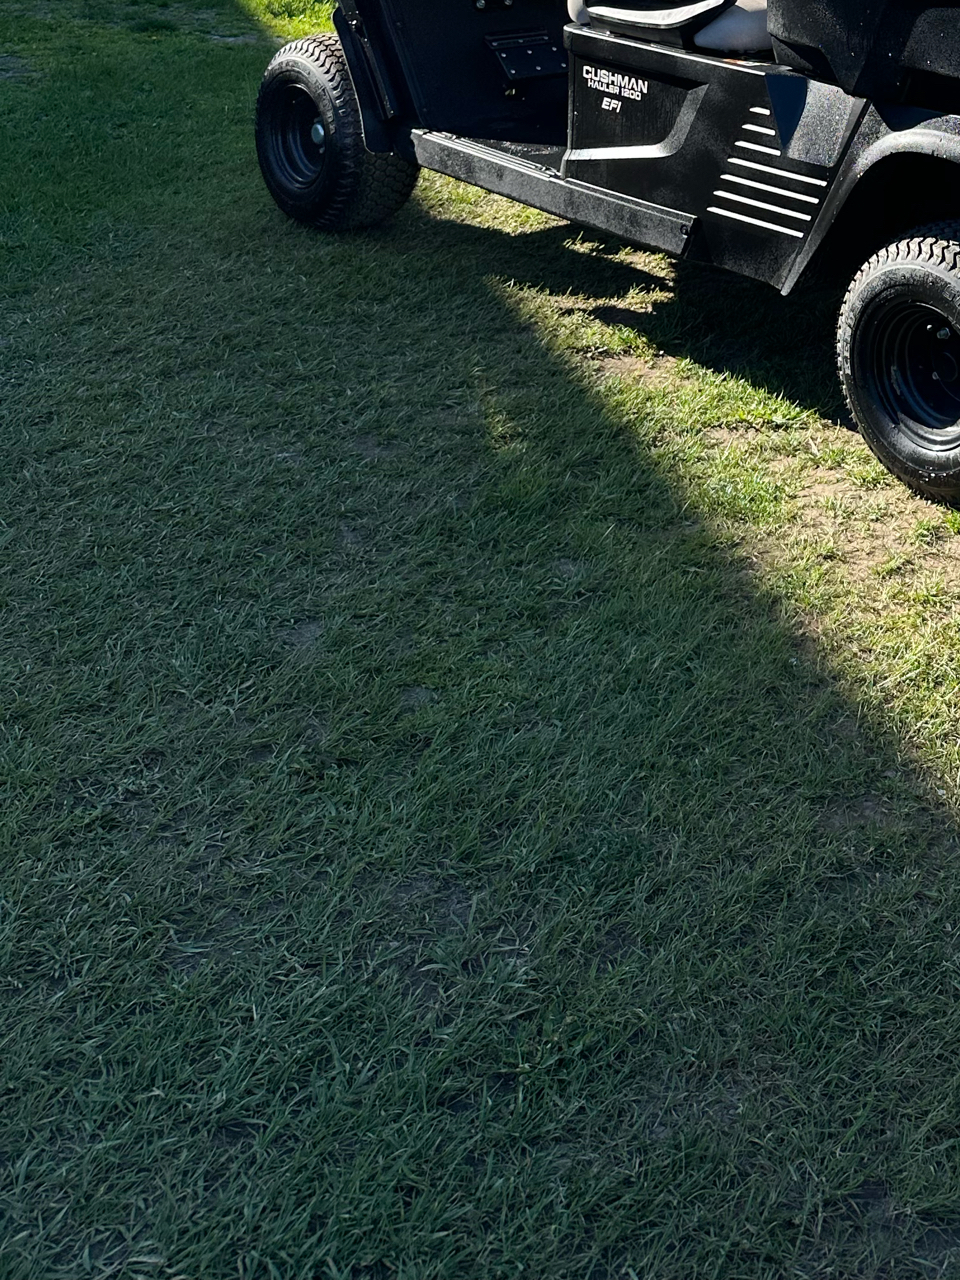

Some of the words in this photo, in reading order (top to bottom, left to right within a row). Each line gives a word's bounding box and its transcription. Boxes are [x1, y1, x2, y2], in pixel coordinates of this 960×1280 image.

[582, 65, 649, 94] CUSHMAN
[587, 78, 620, 95] HAULER
[621, 87, 642, 101] 1200
[601, 96, 622, 113] EFI
